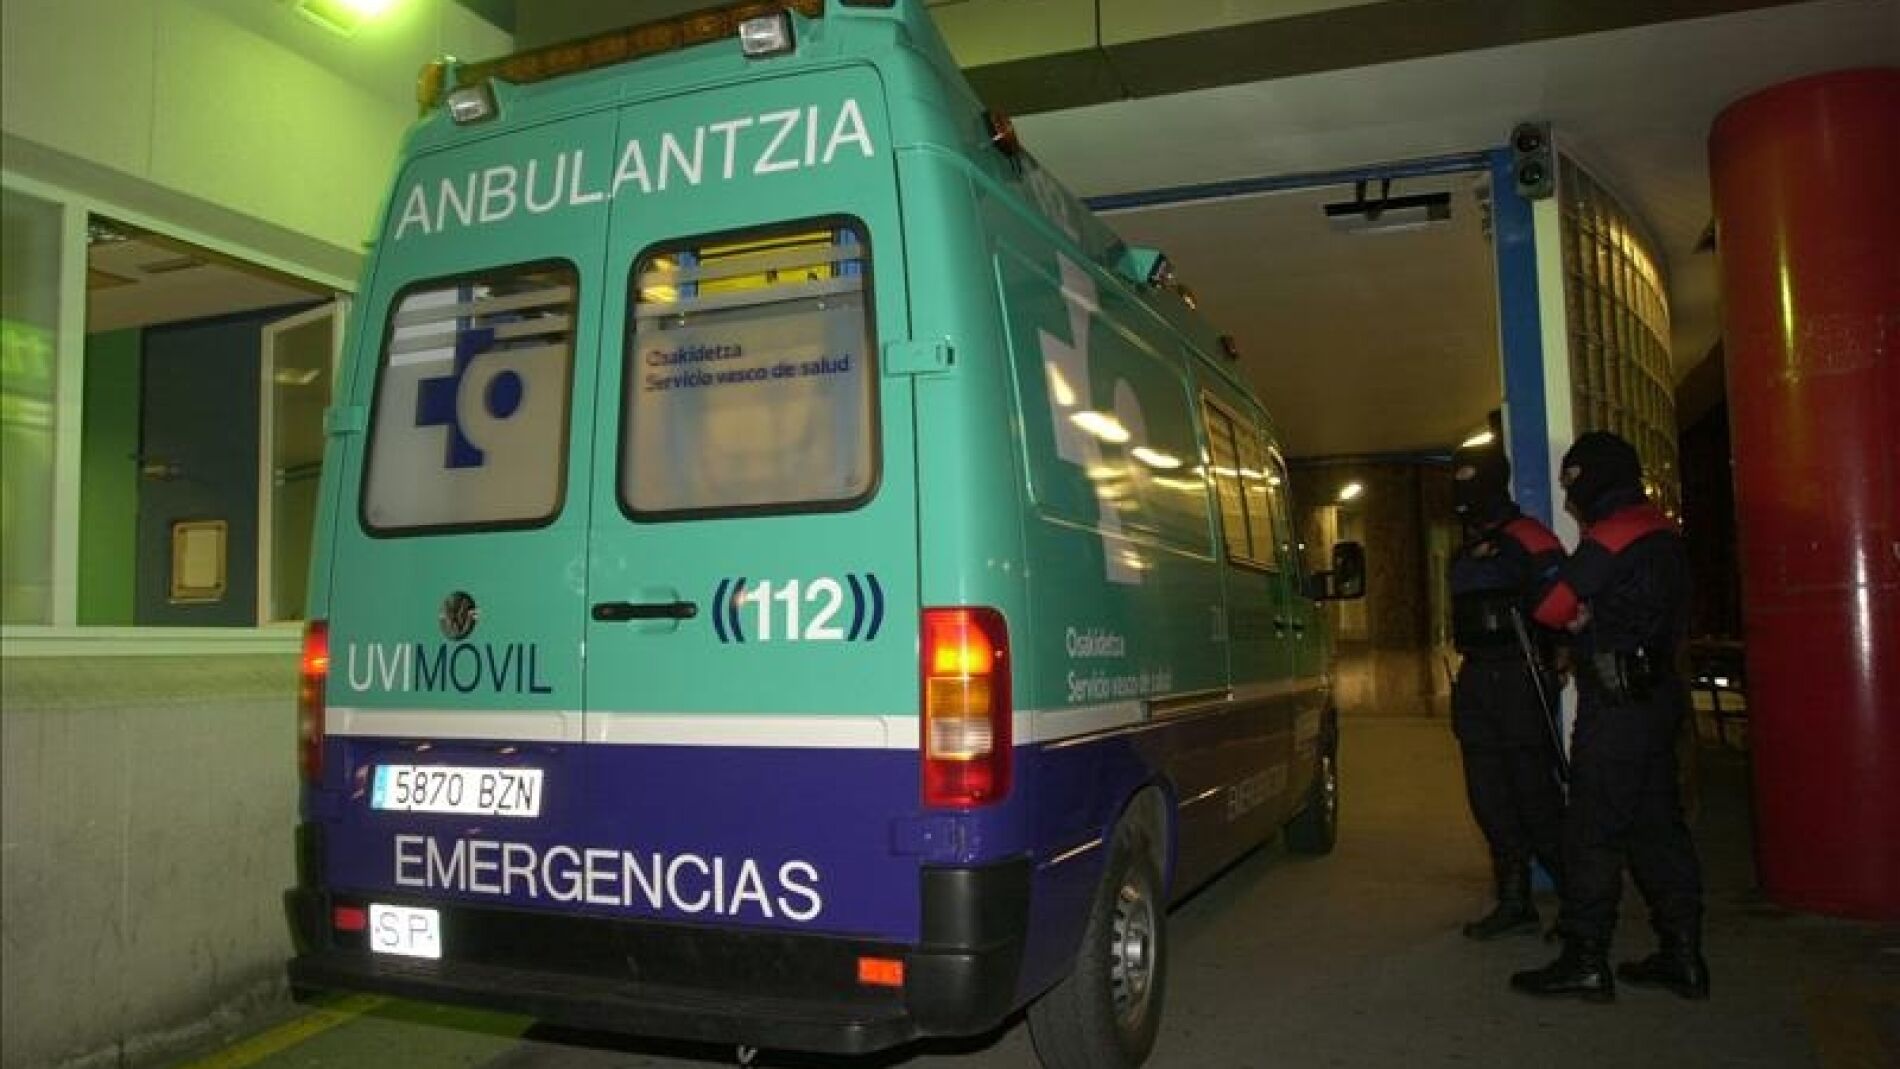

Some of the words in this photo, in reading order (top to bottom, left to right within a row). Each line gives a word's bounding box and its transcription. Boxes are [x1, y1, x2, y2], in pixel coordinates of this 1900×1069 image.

[395, 98, 874, 241] ANBULANTZIA
[645, 343, 743, 368] Osakidetza
[645, 367, 713, 393] Servicio
[717, 366, 768, 385] vasco
[772, 360, 796, 380] de
[800, 353, 850, 376] salud
[396, 771, 464, 807] 5870
[477, 773, 535, 811] BZN
[393, 834, 823, 922] EMERGENCIAS
